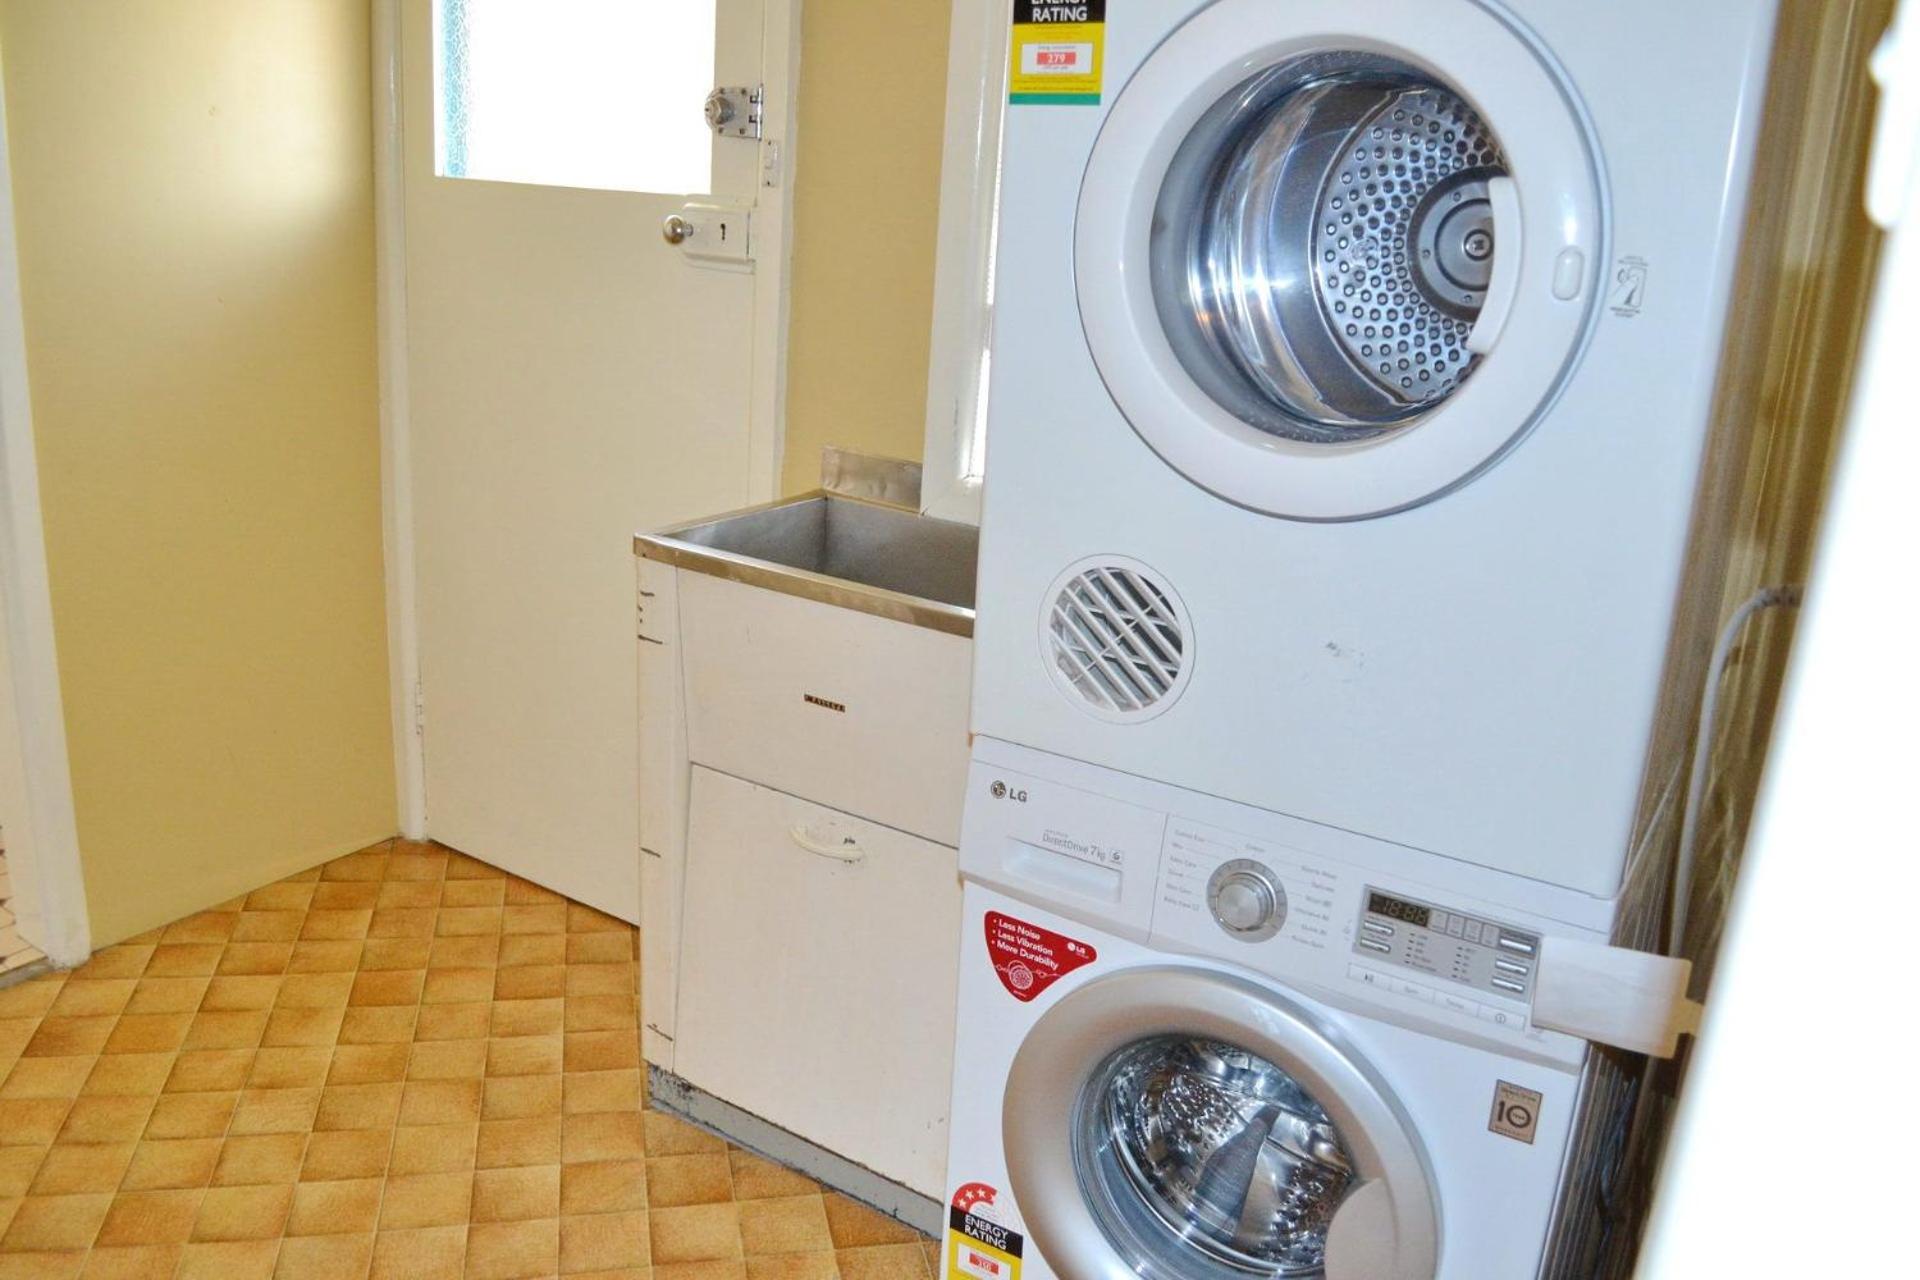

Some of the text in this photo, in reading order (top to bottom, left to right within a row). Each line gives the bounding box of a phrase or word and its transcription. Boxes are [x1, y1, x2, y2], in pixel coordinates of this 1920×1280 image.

[1032, 7, 1088, 22] RATING
[1009, 788, 1027, 802] LG
[999, 919, 1041, 940] Less Noise
[998, 929, 1053, 956] Less Vibration
[997, 940, 1018, 954] More
[1020, 948, 1058, 971] Durability
[964, 1225, 1007, 1250] RATING
[965, 1214, 1008, 1240] ENERGY
